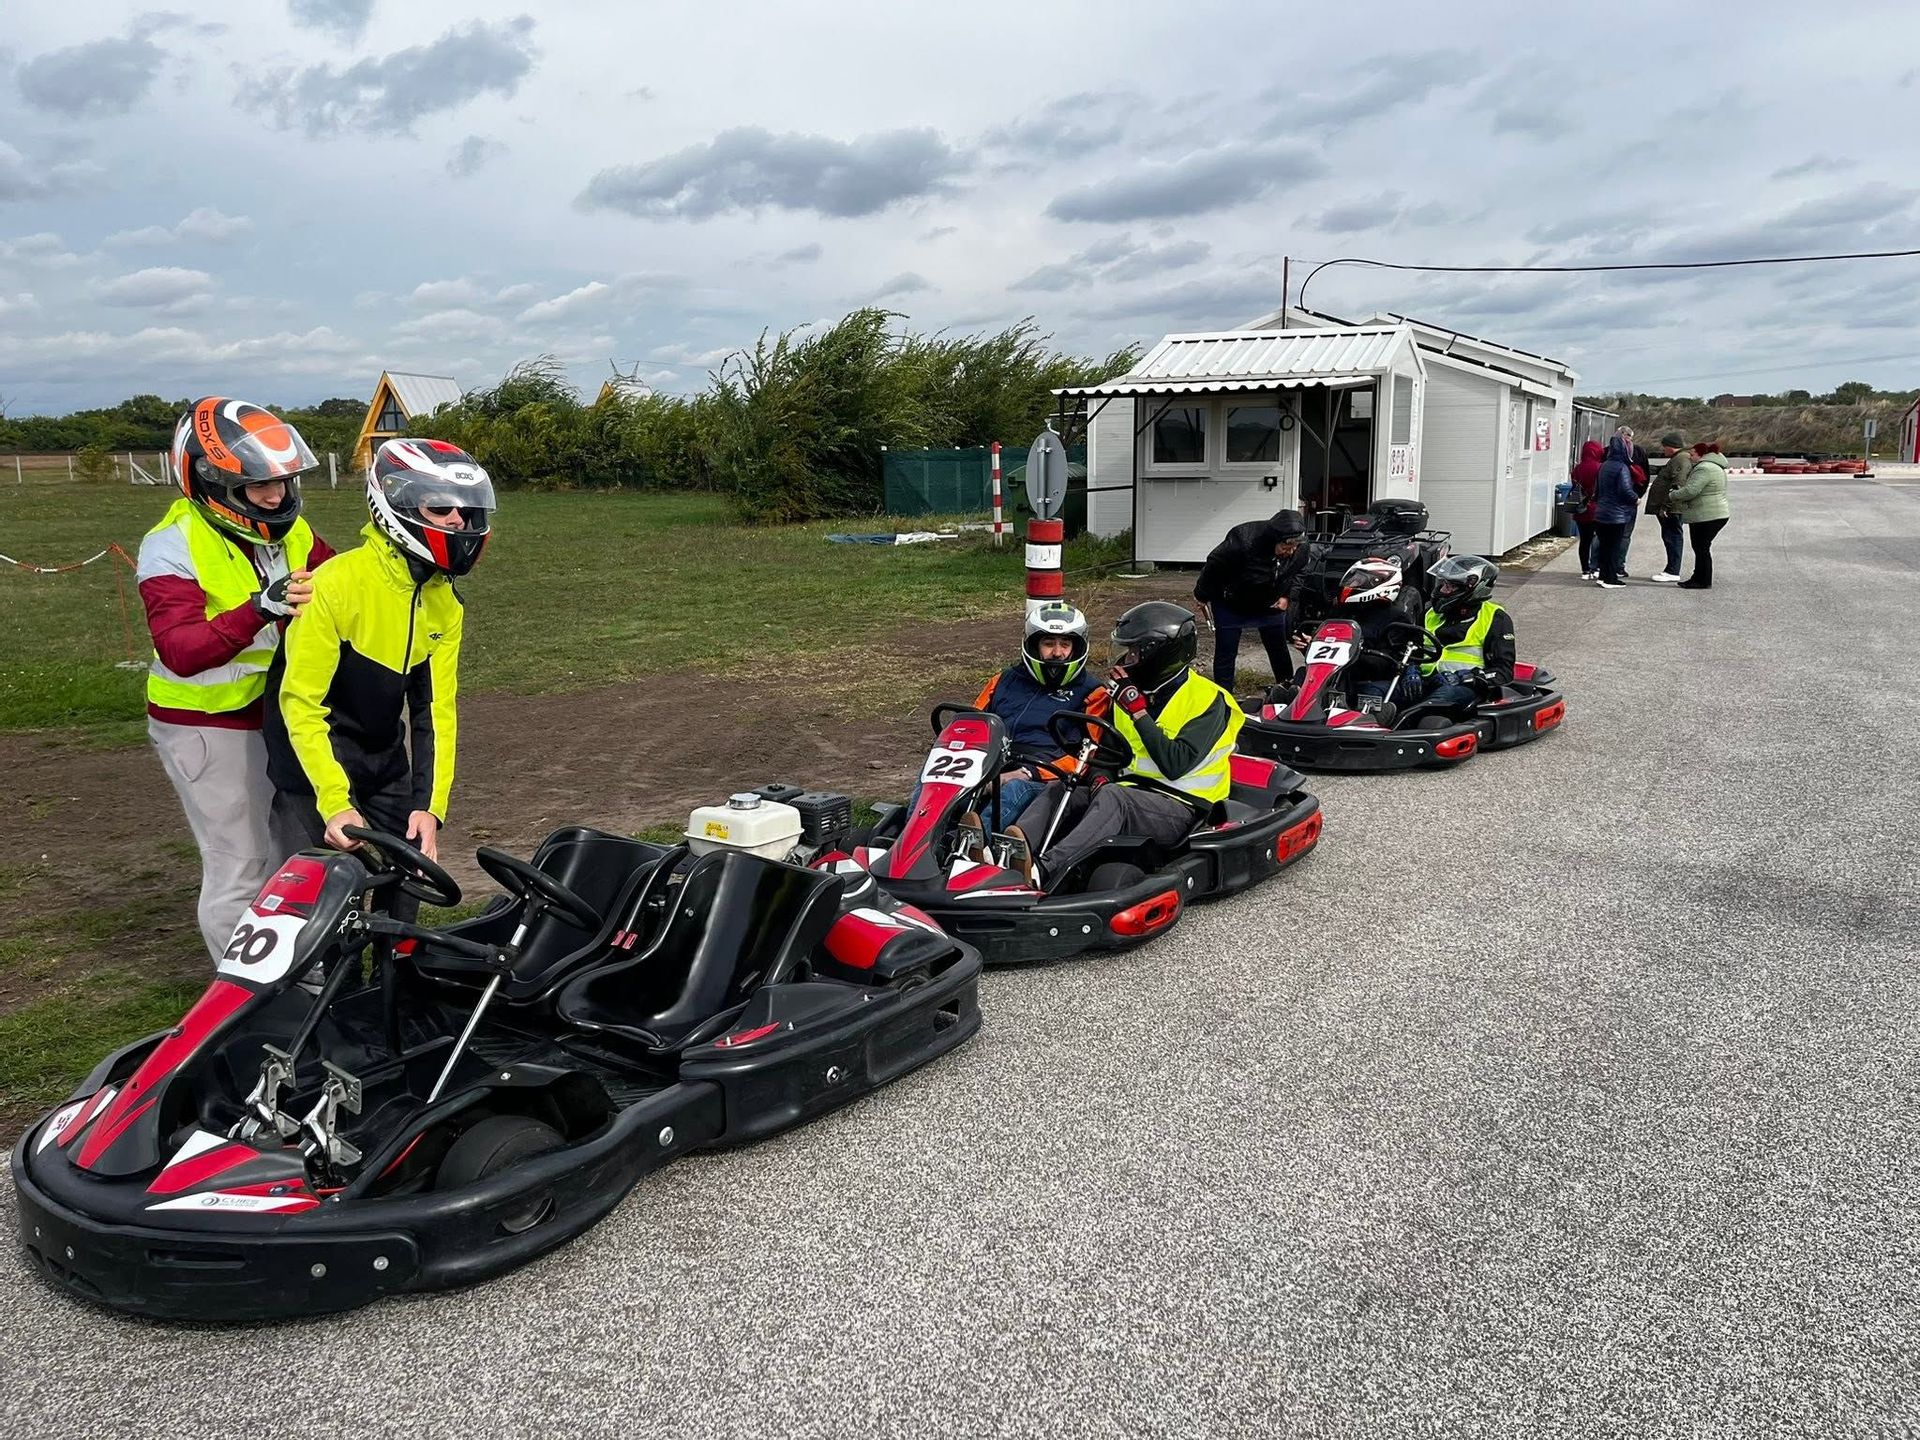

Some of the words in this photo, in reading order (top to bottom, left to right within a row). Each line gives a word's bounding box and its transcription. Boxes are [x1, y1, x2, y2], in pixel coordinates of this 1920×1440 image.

[1313, 645, 1341, 659] 21
[926, 755, 974, 779] 22
[222, 923, 279, 965] 20
